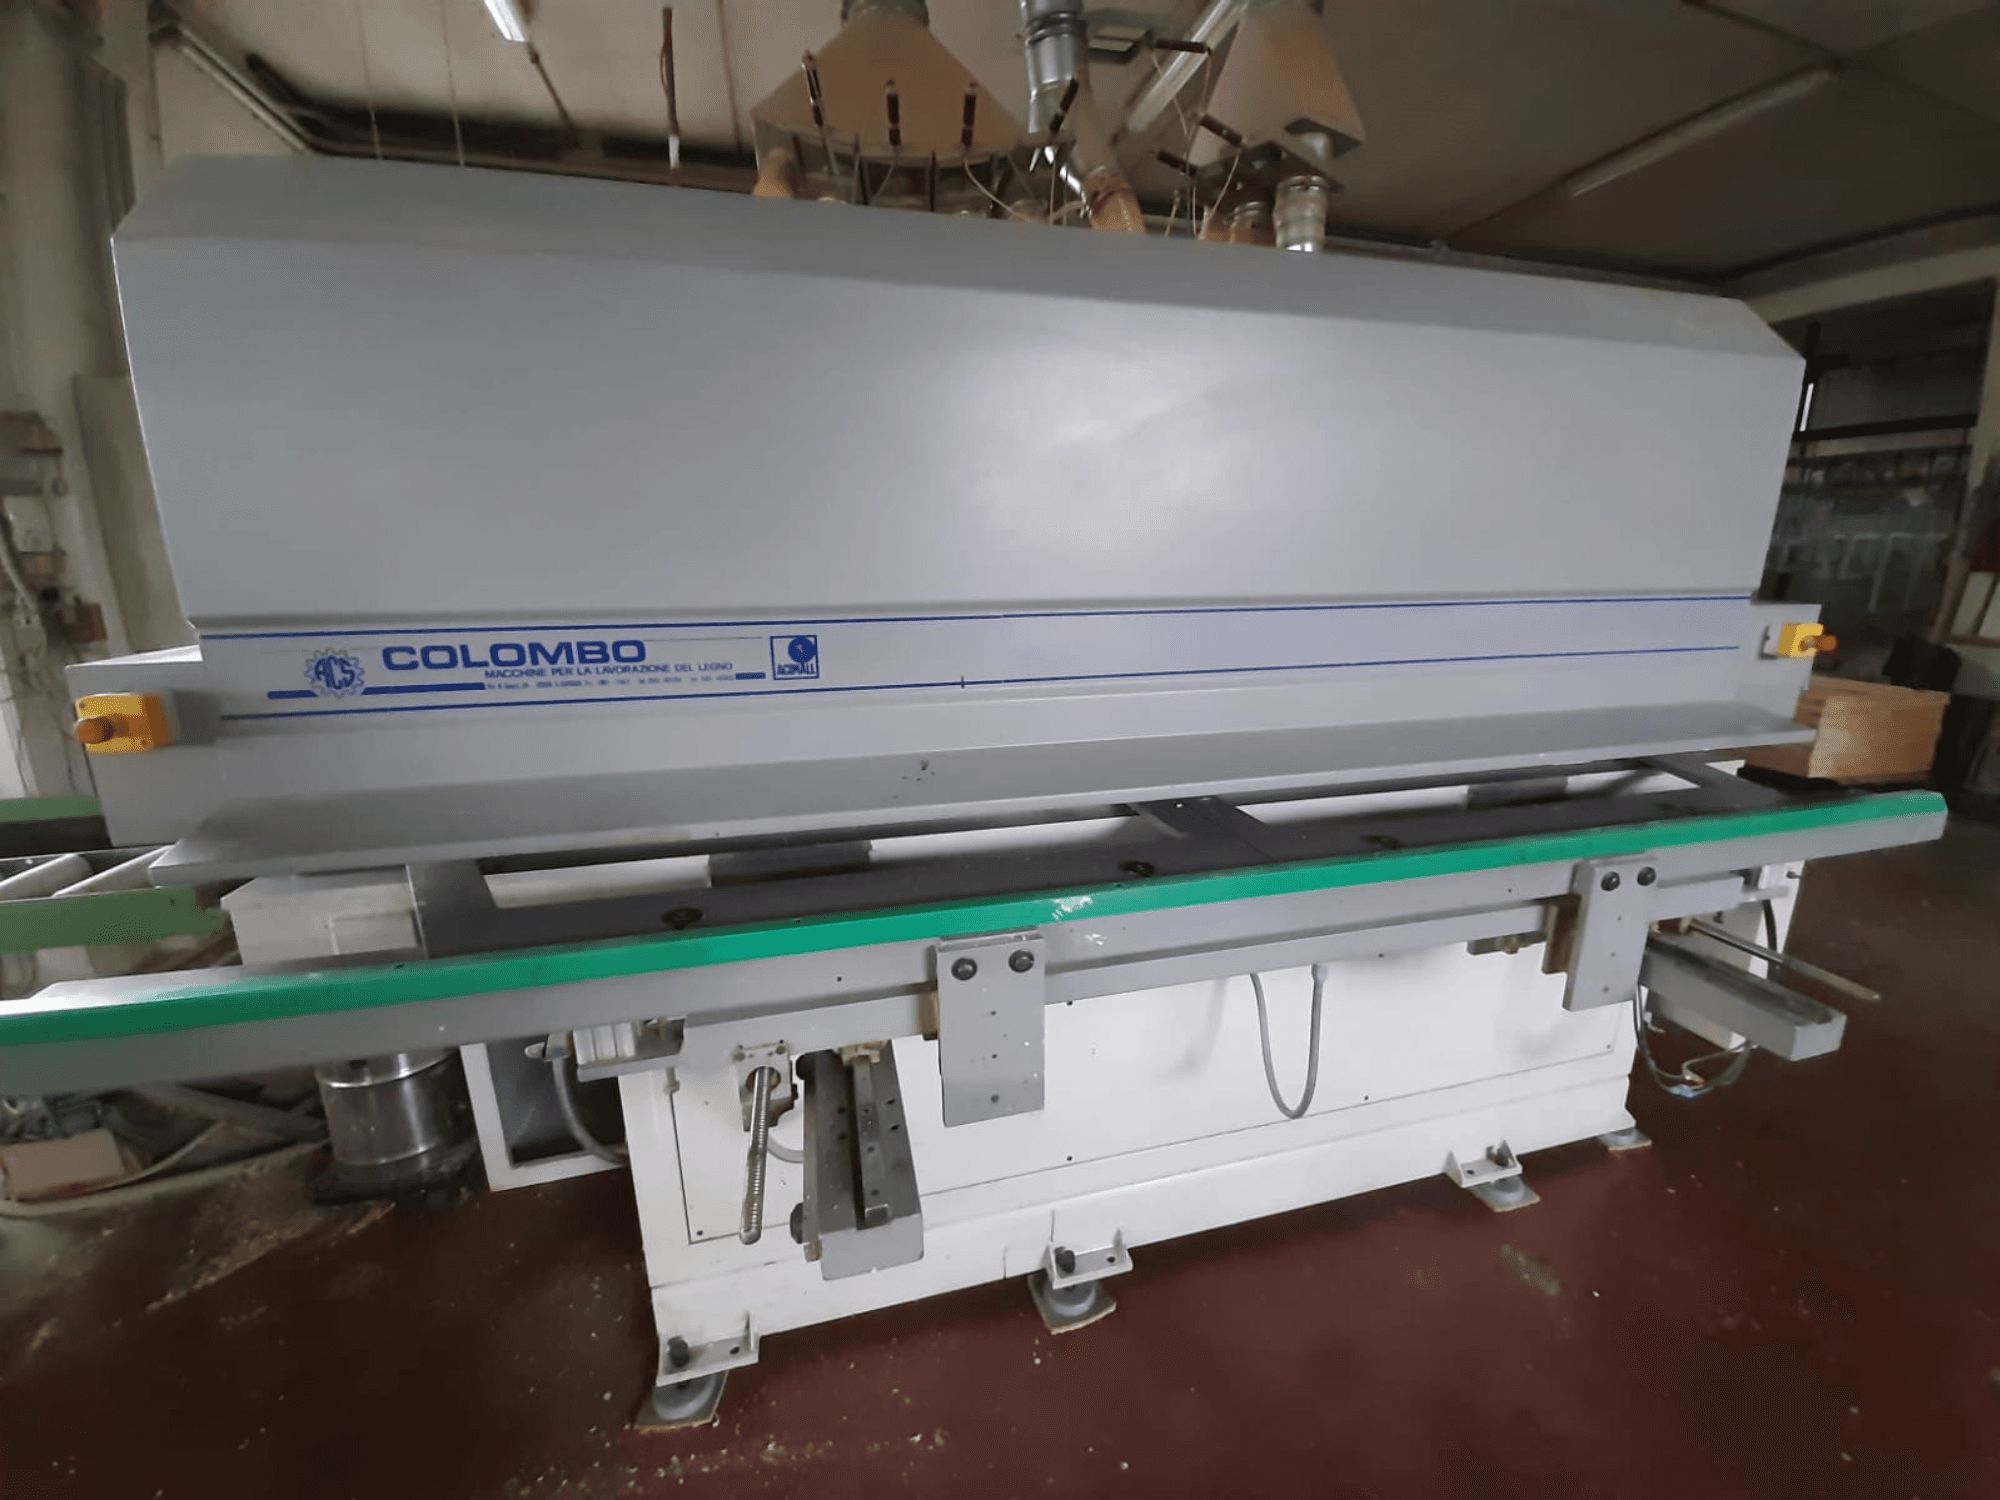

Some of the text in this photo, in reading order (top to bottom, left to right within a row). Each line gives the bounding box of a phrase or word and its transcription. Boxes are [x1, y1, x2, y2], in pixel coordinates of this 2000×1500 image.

[382, 639, 645, 671] COLOMBO
[484, 662, 733, 678] MACCHINE PER LA LAVORAZIONE DEL LEGNO
[314, 655, 356, 690] ACS
